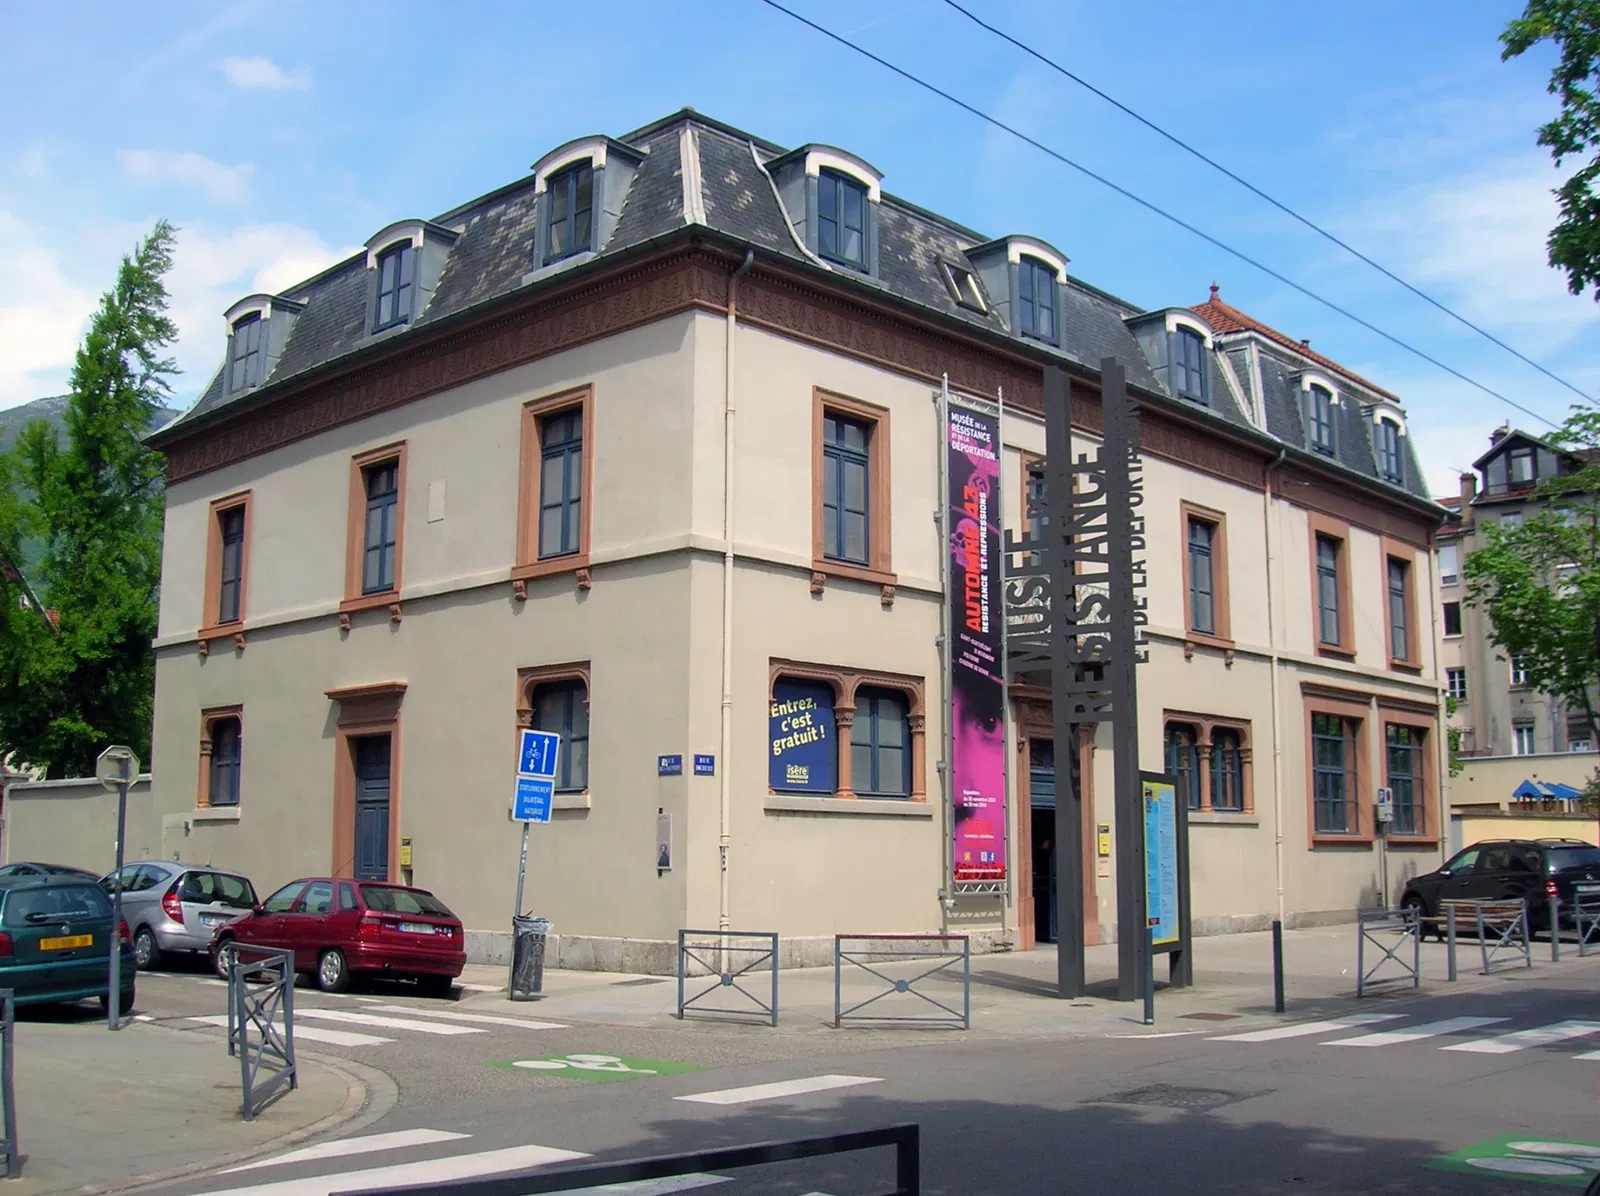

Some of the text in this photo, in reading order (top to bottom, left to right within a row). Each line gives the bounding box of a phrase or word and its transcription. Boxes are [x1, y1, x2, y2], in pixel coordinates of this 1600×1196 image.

[951, 412, 974, 427] MUSÉE
[951, 423, 991, 442] RÉSISTANCE
[951, 441, 995, 460] DÉPORTATION
[964, 485, 980, 632] AUTOMNE 43
[980, 556, 988, 570] ET
[981, 575, 989, 632] RESISTANCE
[771, 697, 817, 718] Entrez,
[781, 712, 813, 732] c'est
[773, 724, 825, 756] gratuit !
[787, 764, 808, 775] isère
